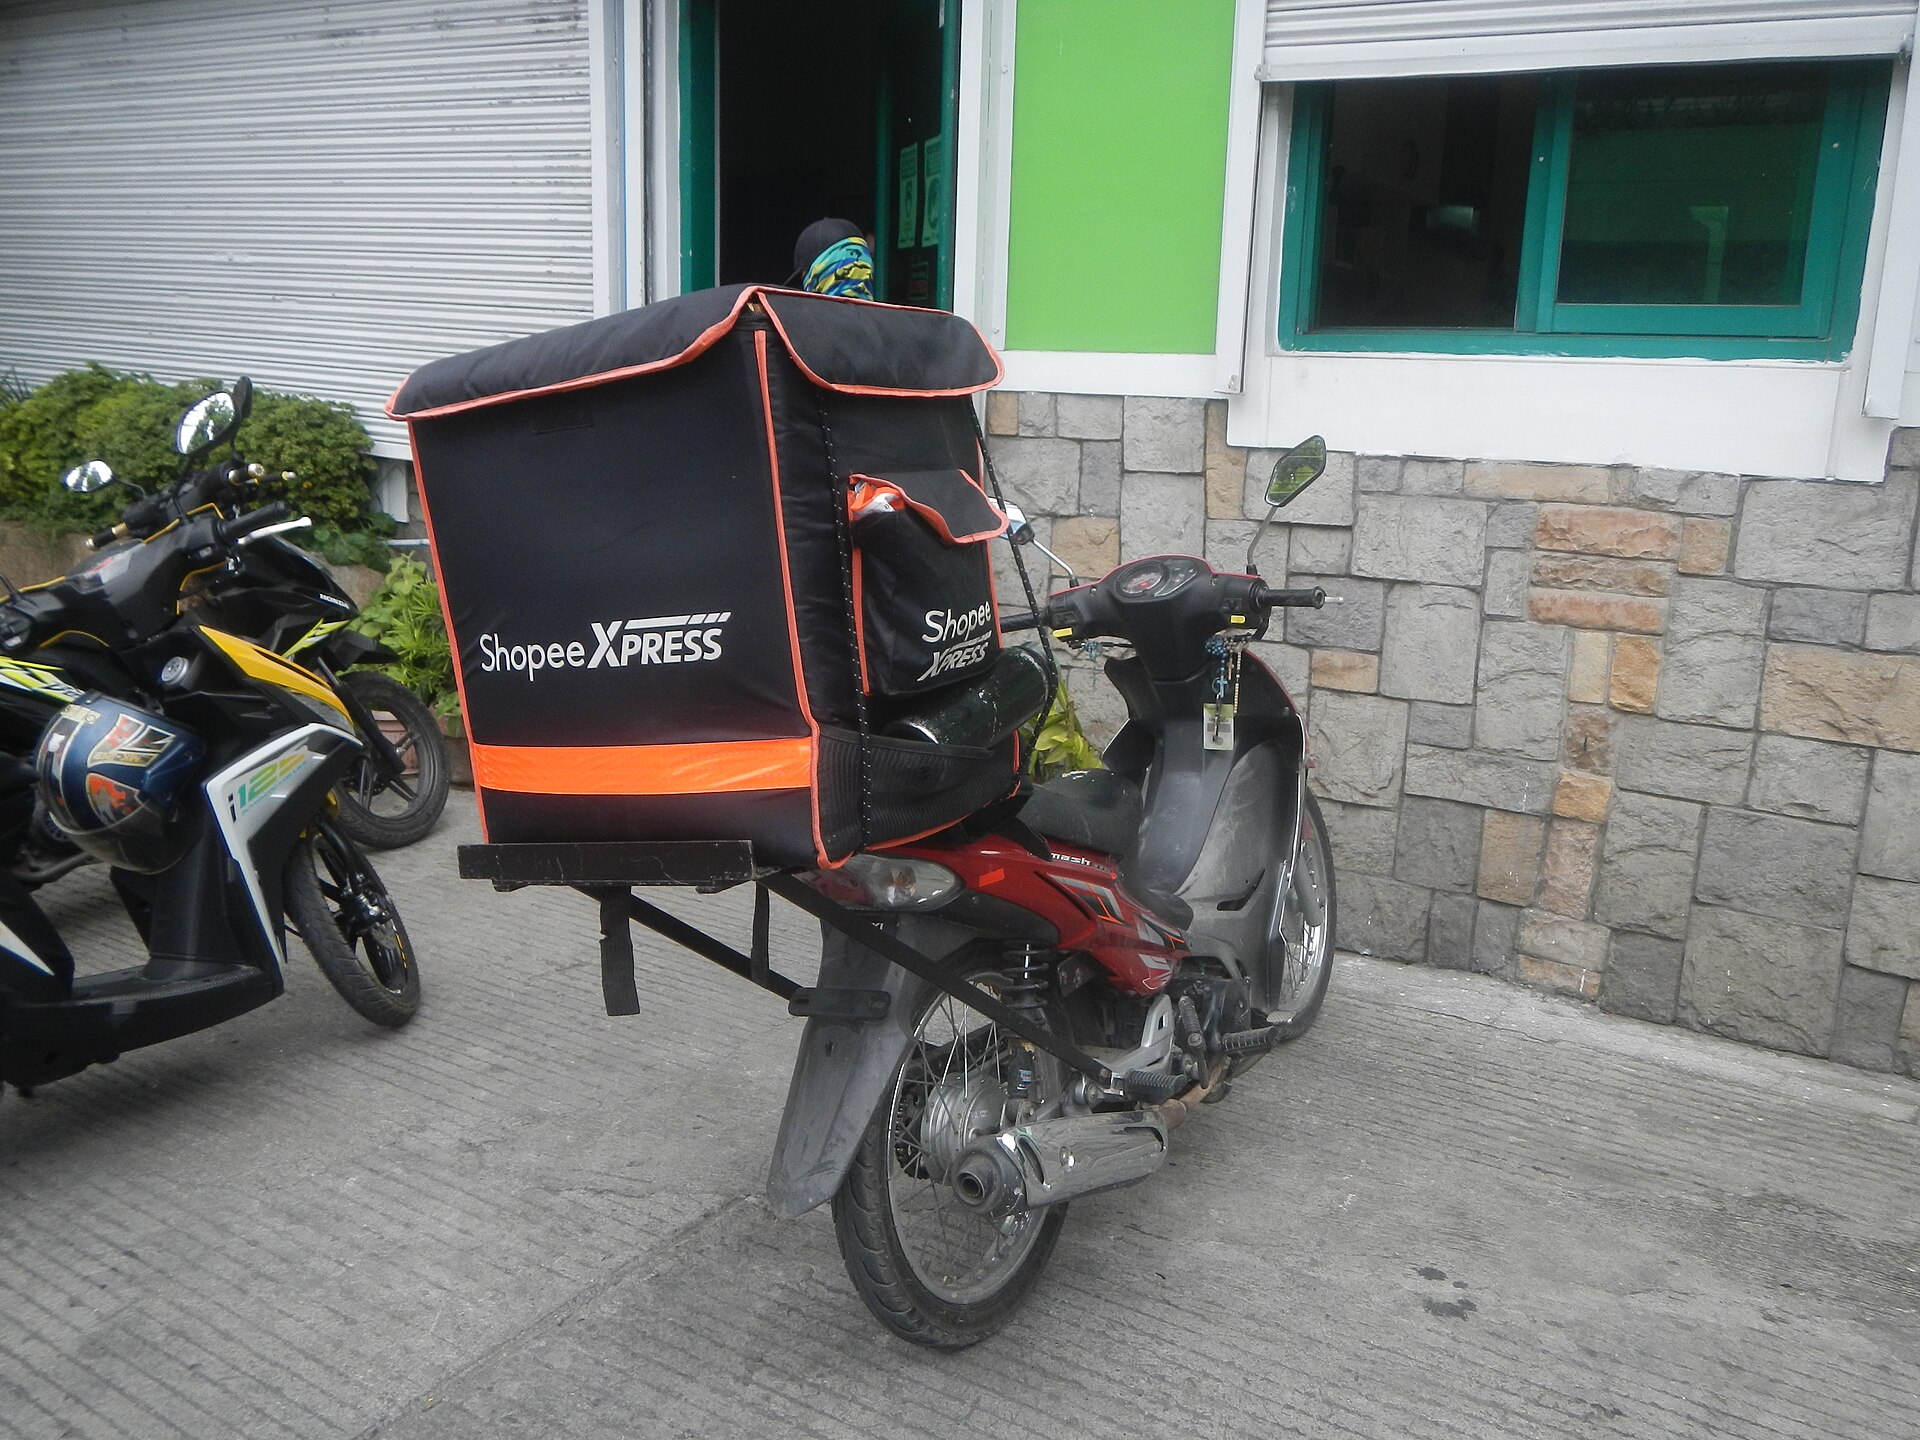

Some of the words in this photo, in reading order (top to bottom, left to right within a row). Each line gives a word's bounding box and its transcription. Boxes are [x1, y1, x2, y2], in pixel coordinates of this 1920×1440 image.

[319, 593, 350, 610] HONDA
[921, 601, 992, 643] Shopee
[479, 633, 586, 682] Shopee
[586, 614, 728, 669] XPRESS
[916, 640, 991, 682] XPRESS
